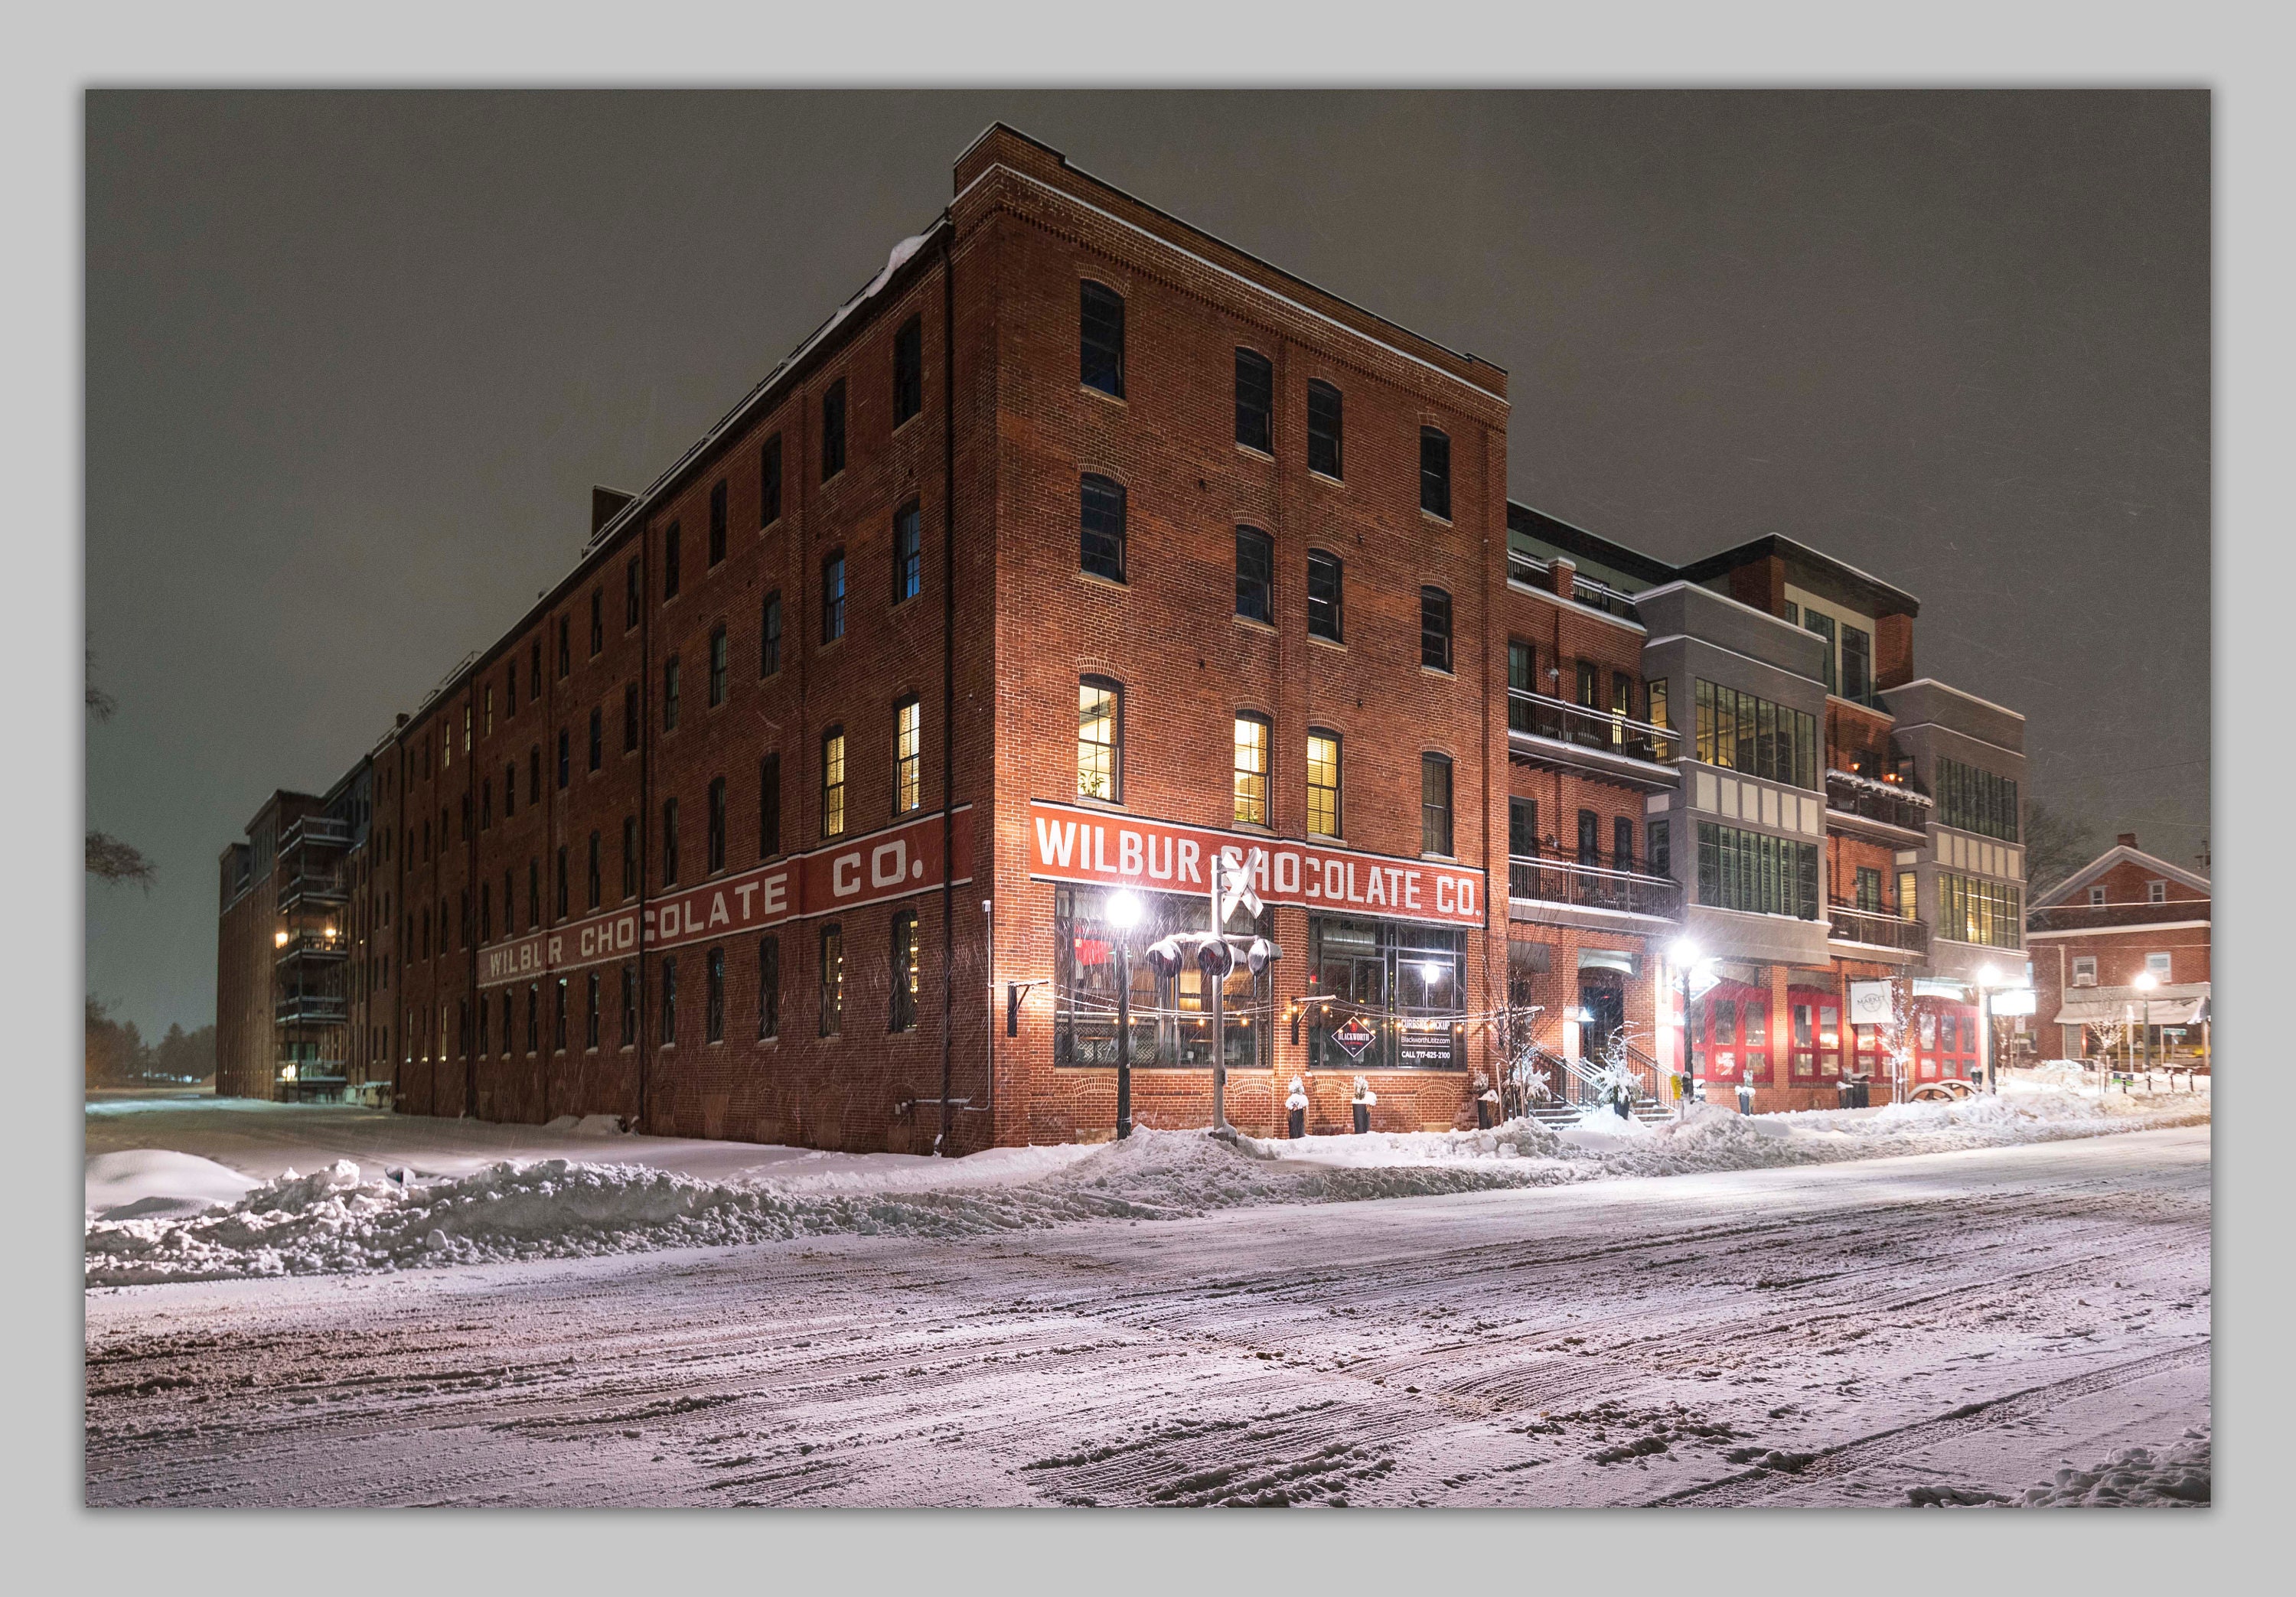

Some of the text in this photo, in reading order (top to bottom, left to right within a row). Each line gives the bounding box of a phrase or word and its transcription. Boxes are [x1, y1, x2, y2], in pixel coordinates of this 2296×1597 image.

[1035, 816, 1202, 884] WILBUR
[1436, 875, 1482, 916] CO.
[491, 839, 923, 978] WILBUR CHOCOLATE CO.
[1338, 1032, 1370, 1041] BLACKWORTH
[1416, 1051, 1450, 1059] 717-625-2100
